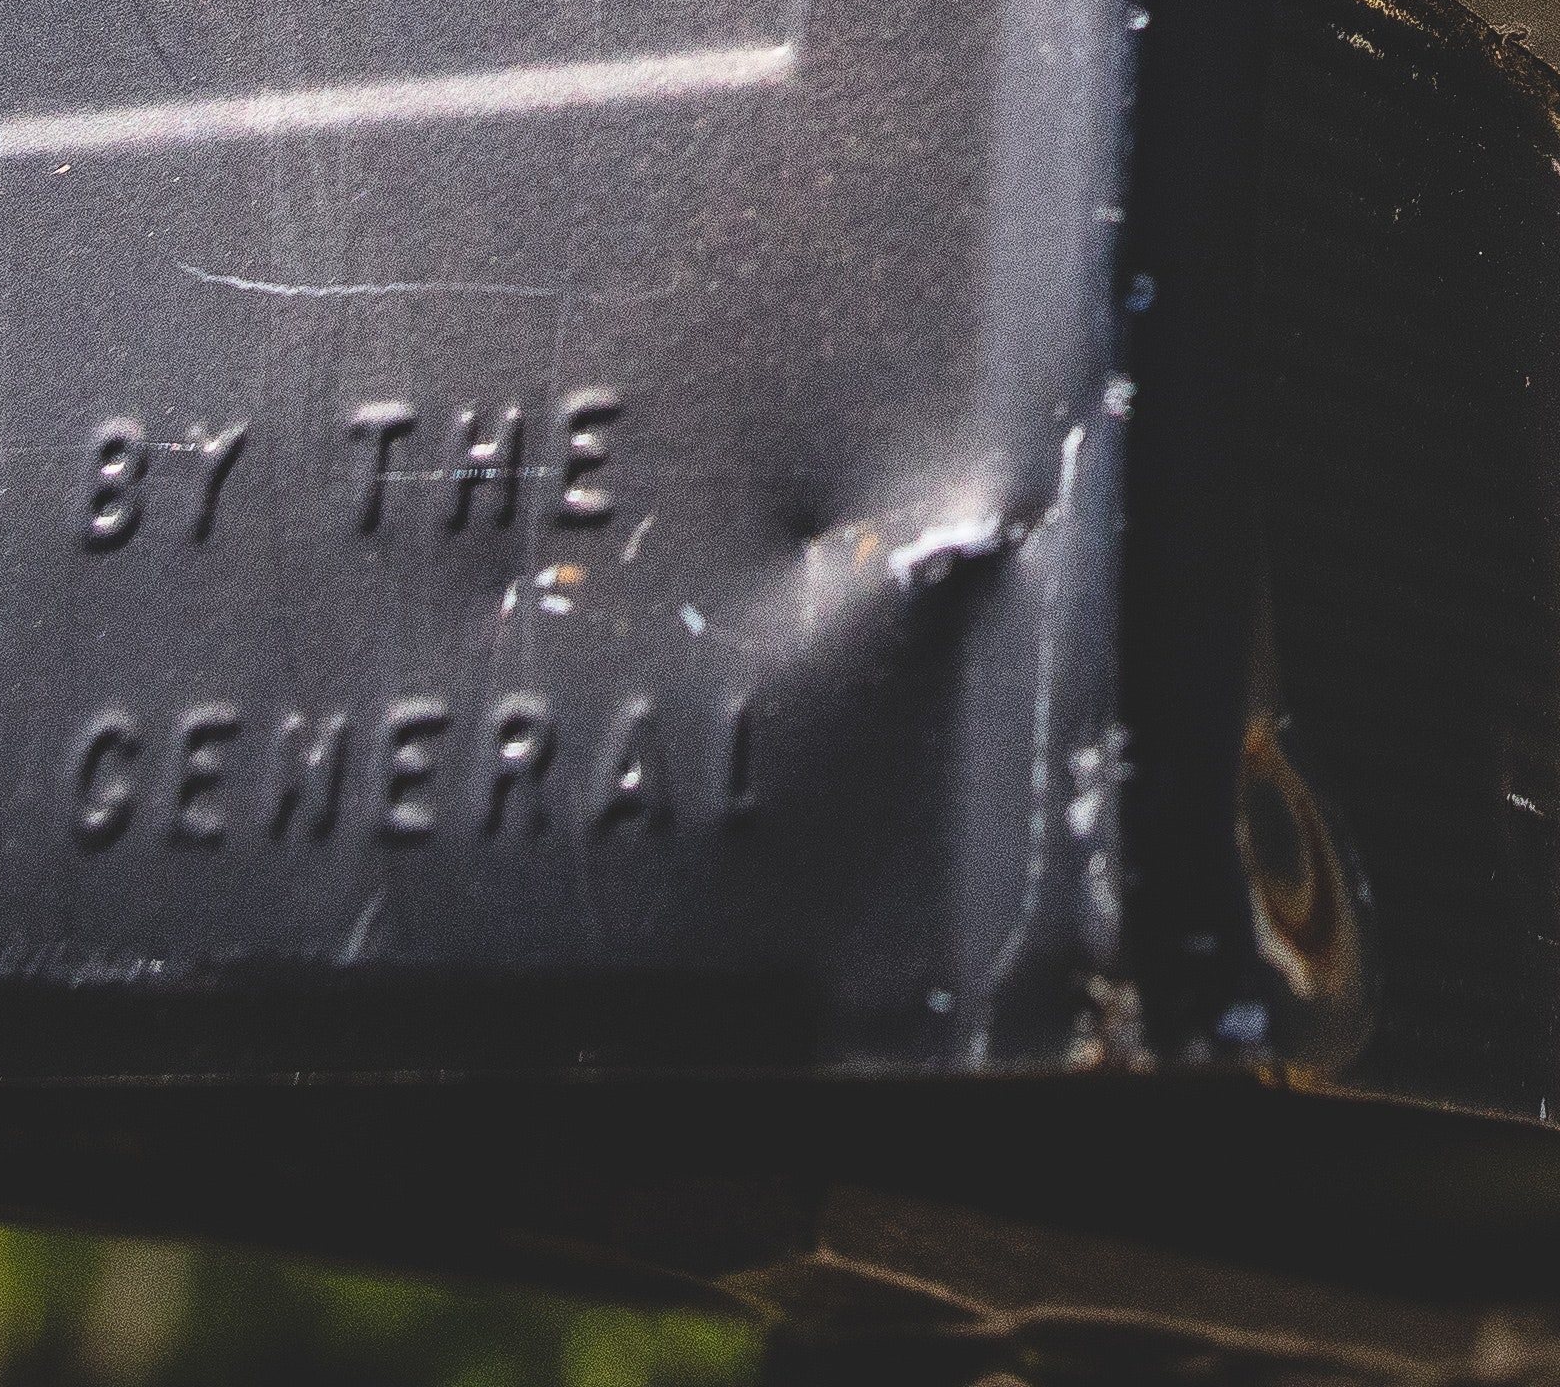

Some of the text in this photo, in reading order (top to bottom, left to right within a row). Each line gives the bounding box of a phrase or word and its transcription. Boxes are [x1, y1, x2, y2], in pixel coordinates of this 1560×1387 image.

[70, 409, 254, 557] BY
[342, 382, 630, 537] THE
[68, 685, 770, 855] GENERAL
